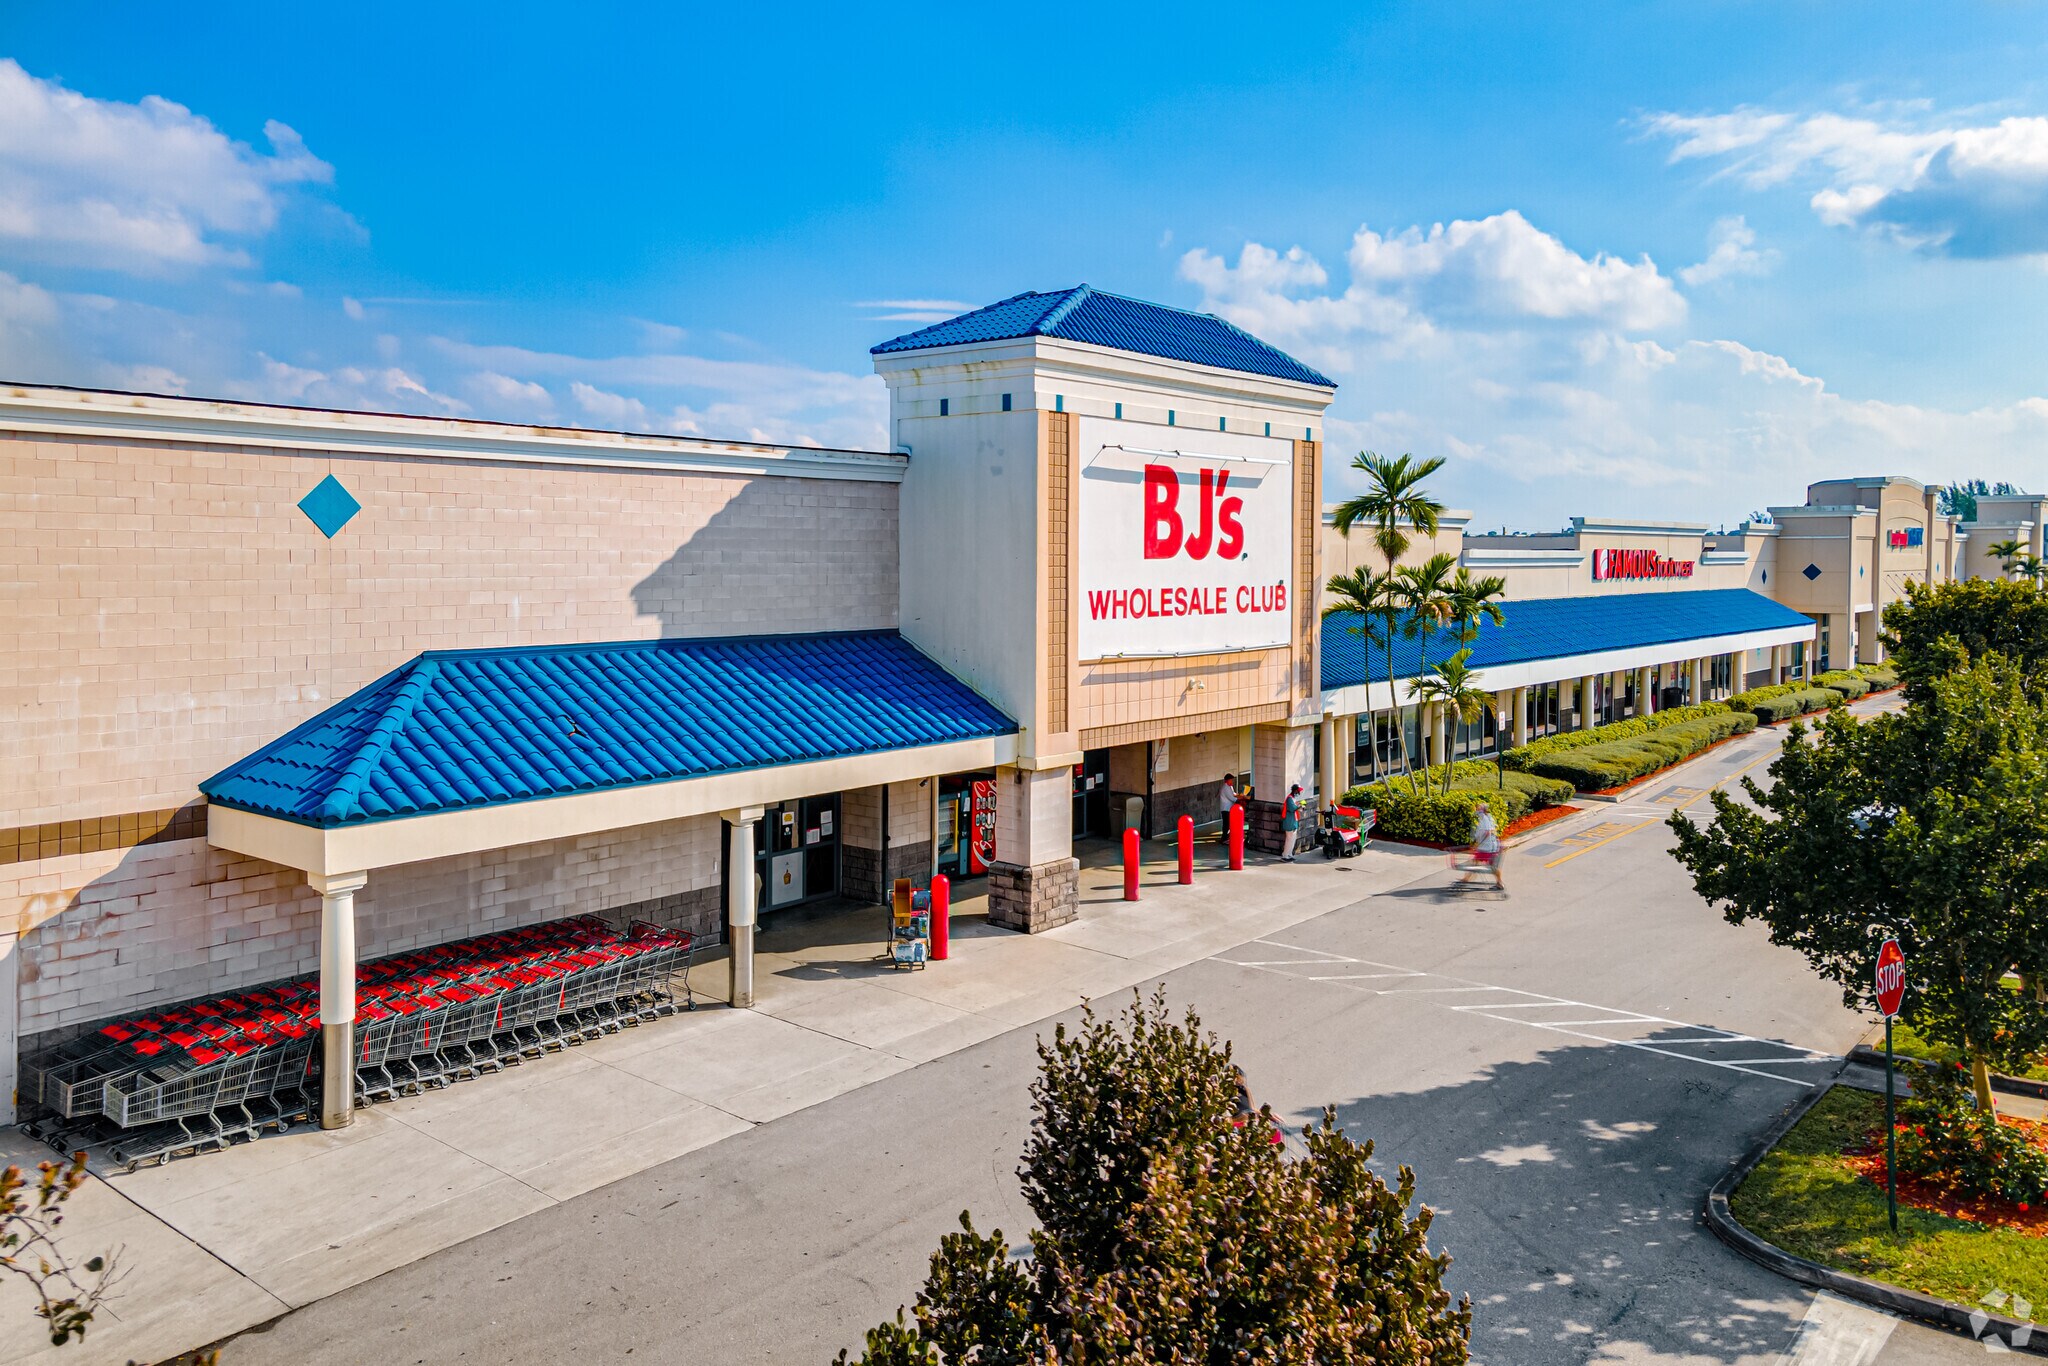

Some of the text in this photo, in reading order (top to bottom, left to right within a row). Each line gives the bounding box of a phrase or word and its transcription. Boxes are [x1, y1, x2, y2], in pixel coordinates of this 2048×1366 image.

[1144, 464, 1245, 560] BJ's
[1608, 549, 1656, 579] FAMOUS
[1088, 585, 1286, 620] WHOLESALE CLUB
[1878, 961, 1903, 995] STOP
